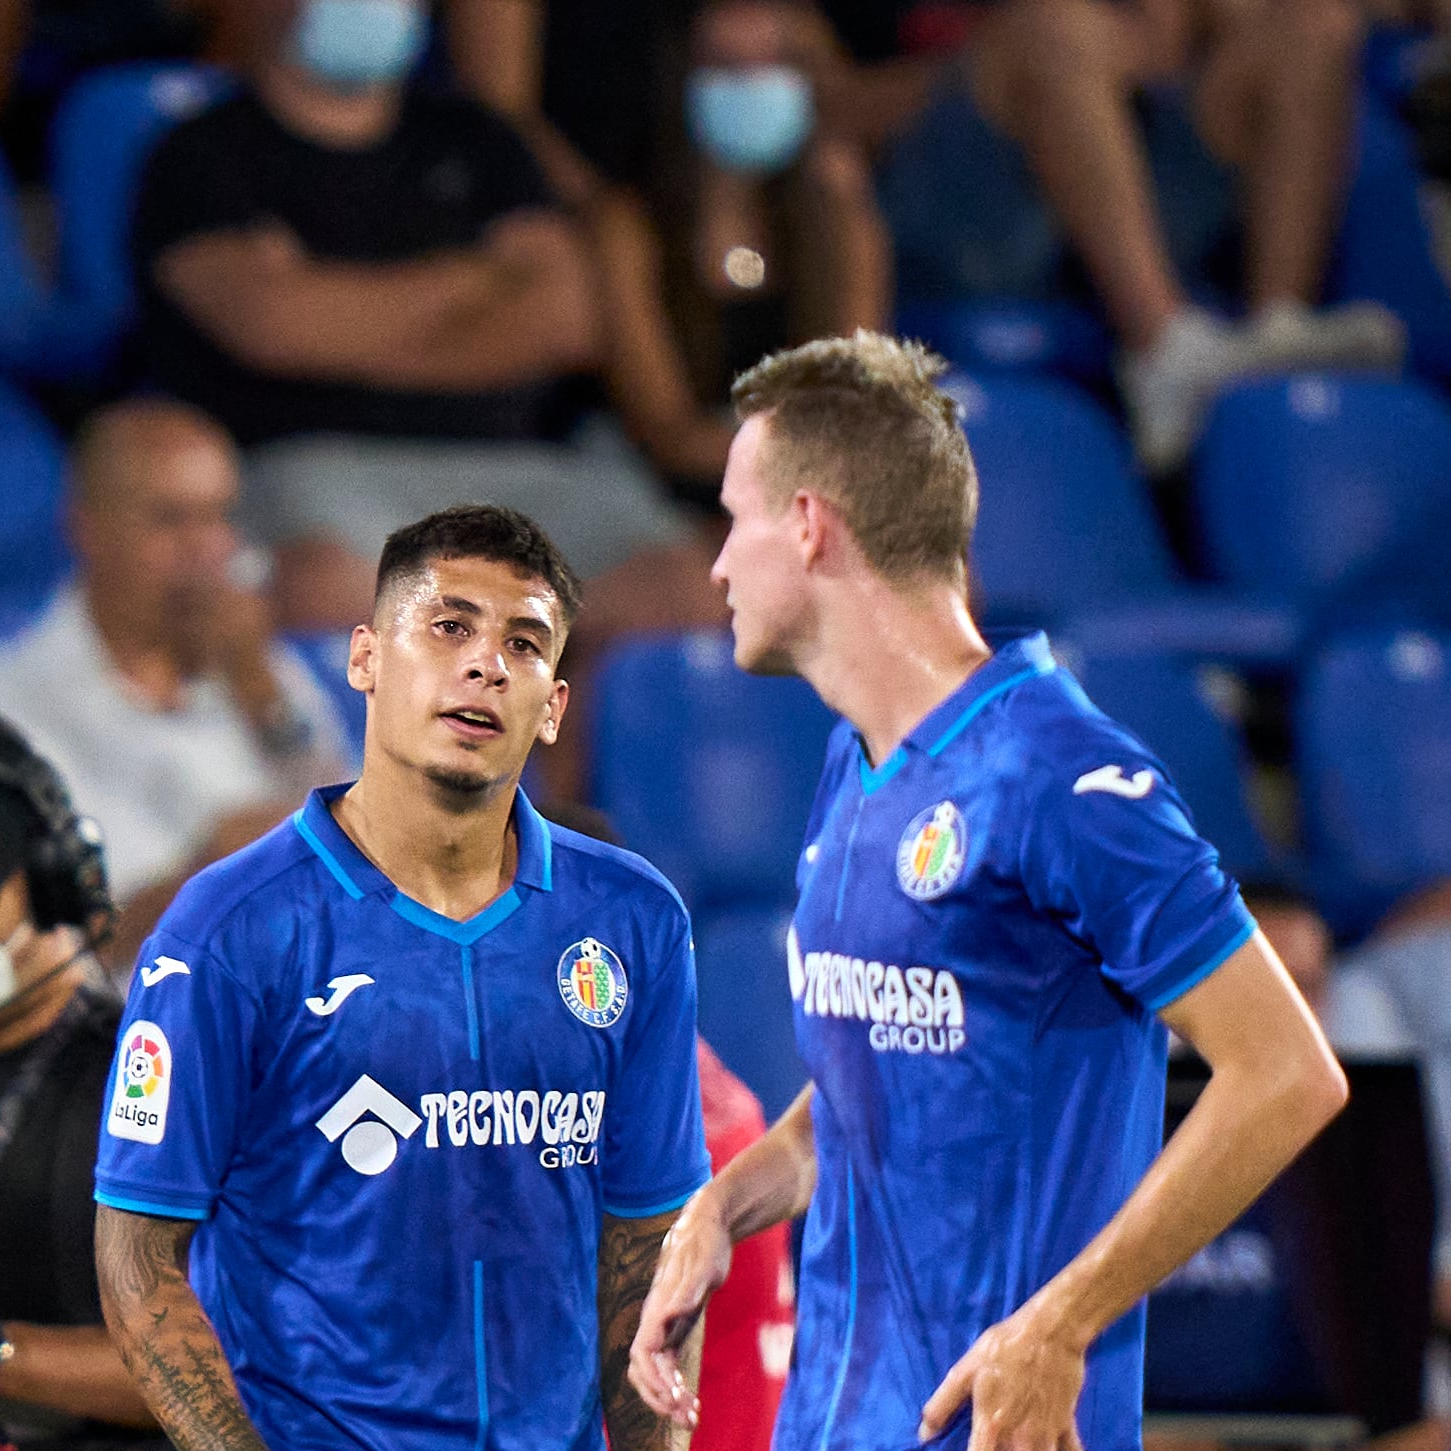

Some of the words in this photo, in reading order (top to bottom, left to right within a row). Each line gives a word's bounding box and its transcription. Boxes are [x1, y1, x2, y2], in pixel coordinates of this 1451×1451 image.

[560, 978, 590, 1021] GETAFE
[803, 951, 965, 1028] TECNOCASA
[868, 1022, 966, 1054] GROUP
[420, 1089, 606, 1148] TECNOCASA
